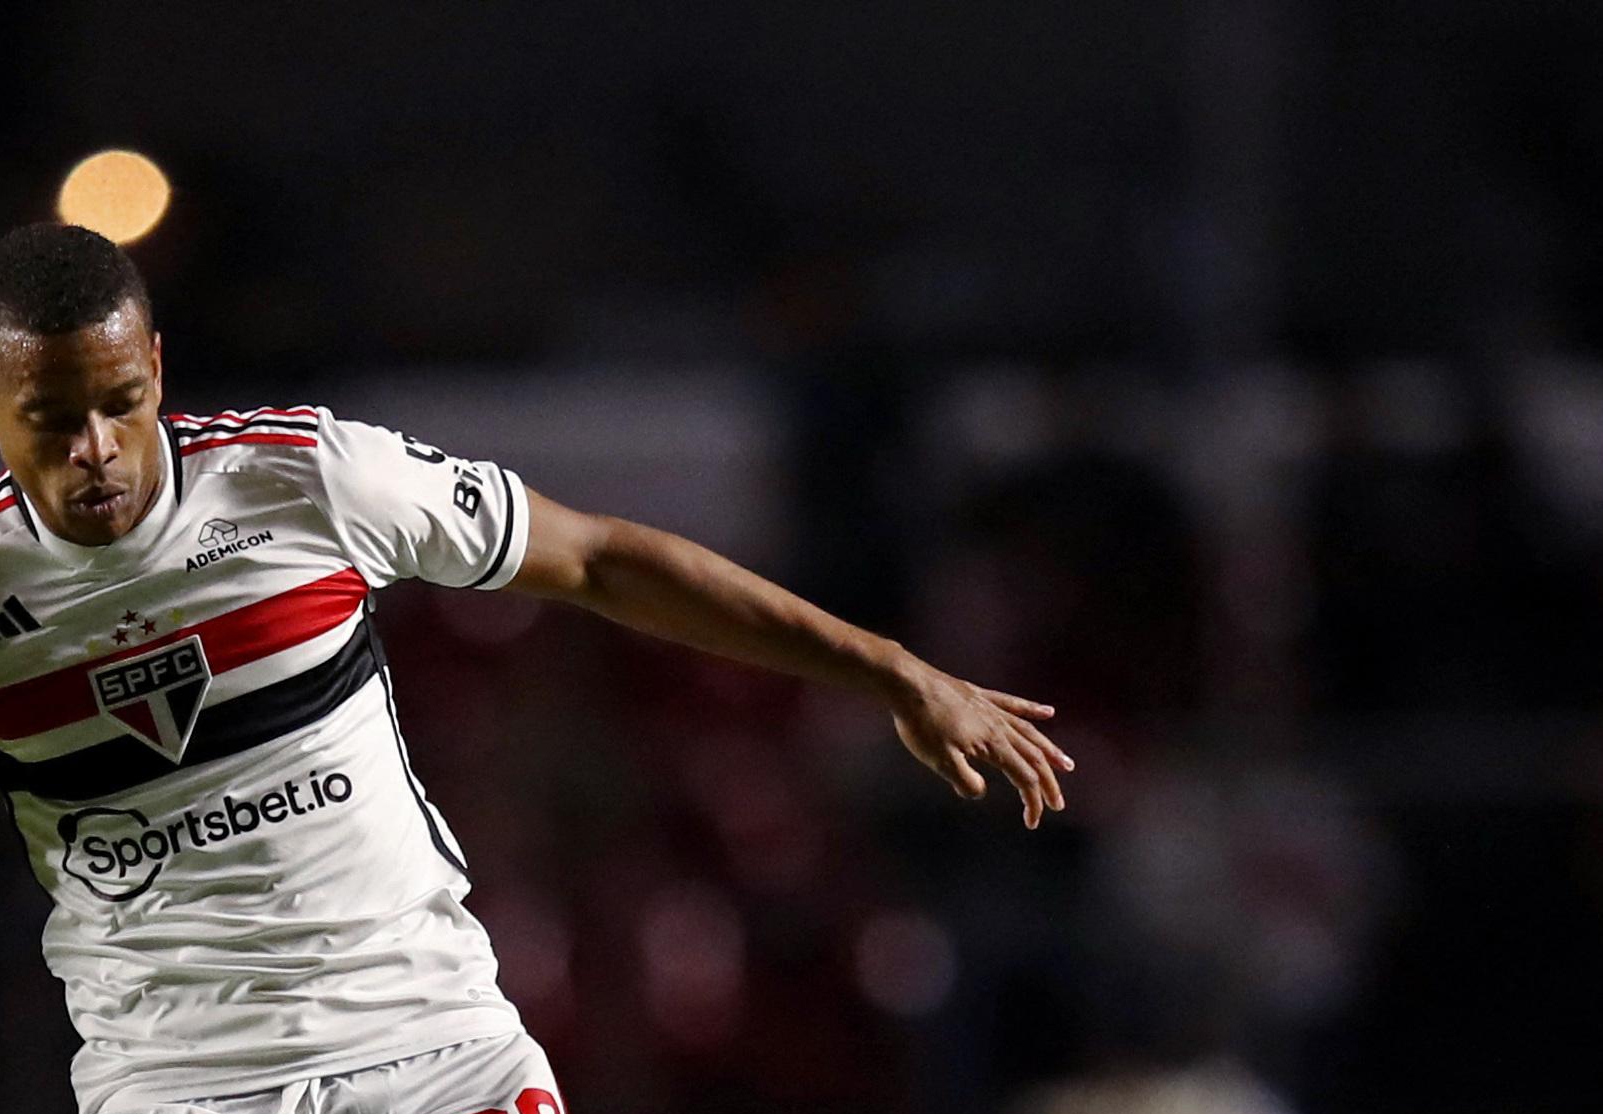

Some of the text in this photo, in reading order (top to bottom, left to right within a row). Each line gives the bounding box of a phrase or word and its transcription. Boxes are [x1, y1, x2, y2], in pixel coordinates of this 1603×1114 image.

[453, 464, 483, 520] Bi
[185, 530, 274, 574] ADEMICON
[101, 648, 197, 700] SPFC
[82, 770, 353, 879] Sportsbet.io
